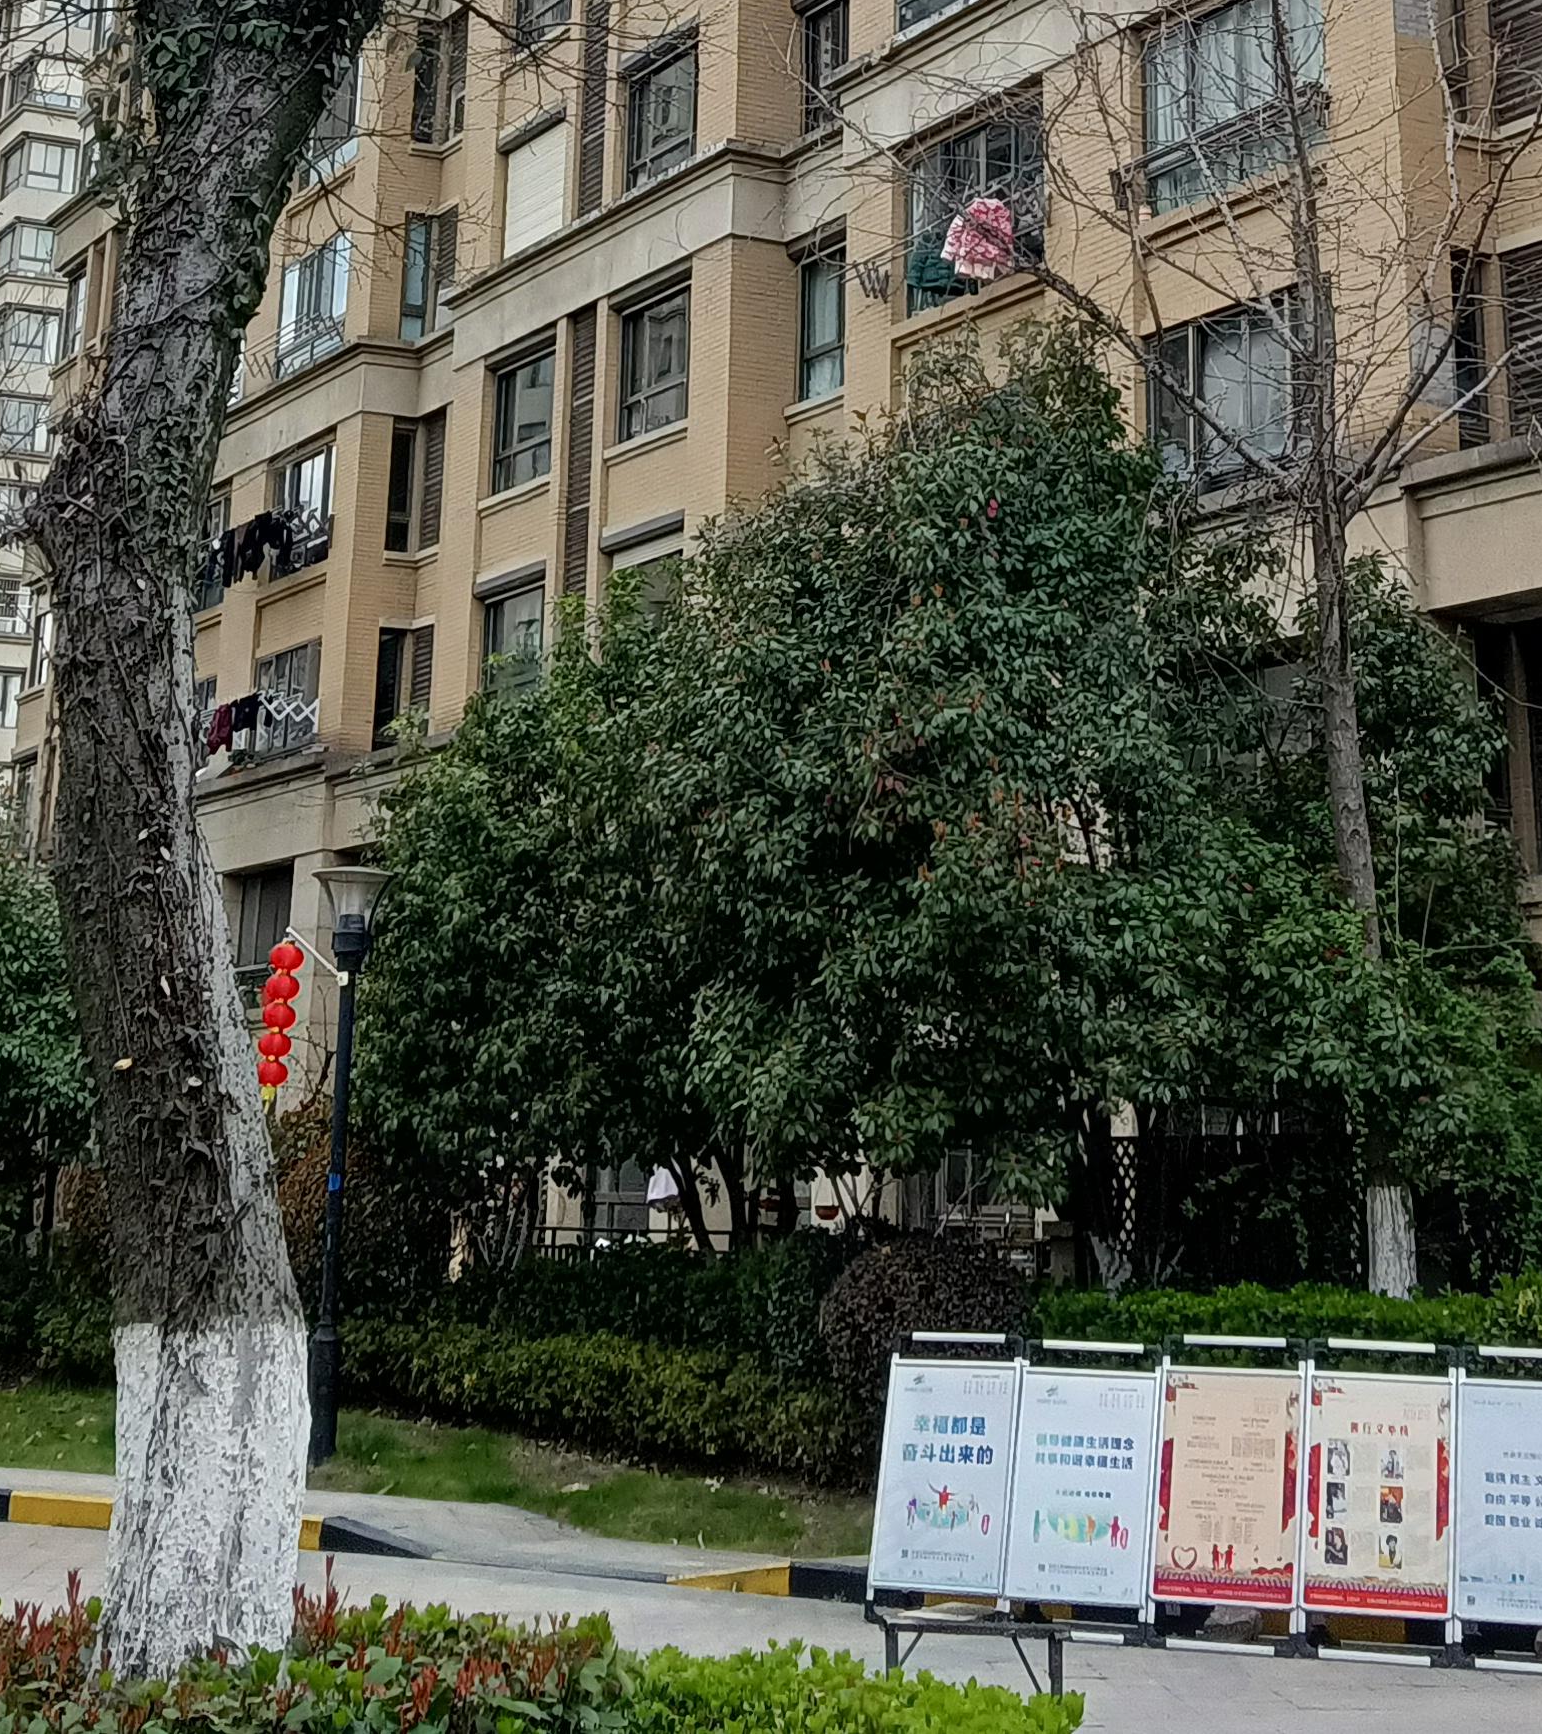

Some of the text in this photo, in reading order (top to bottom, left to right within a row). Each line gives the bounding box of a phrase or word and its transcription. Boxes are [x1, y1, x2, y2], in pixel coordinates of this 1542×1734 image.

[912, 1414, 987, 1436] 幸福都是
[902, 1442, 994, 1465] 奋斗出来的
